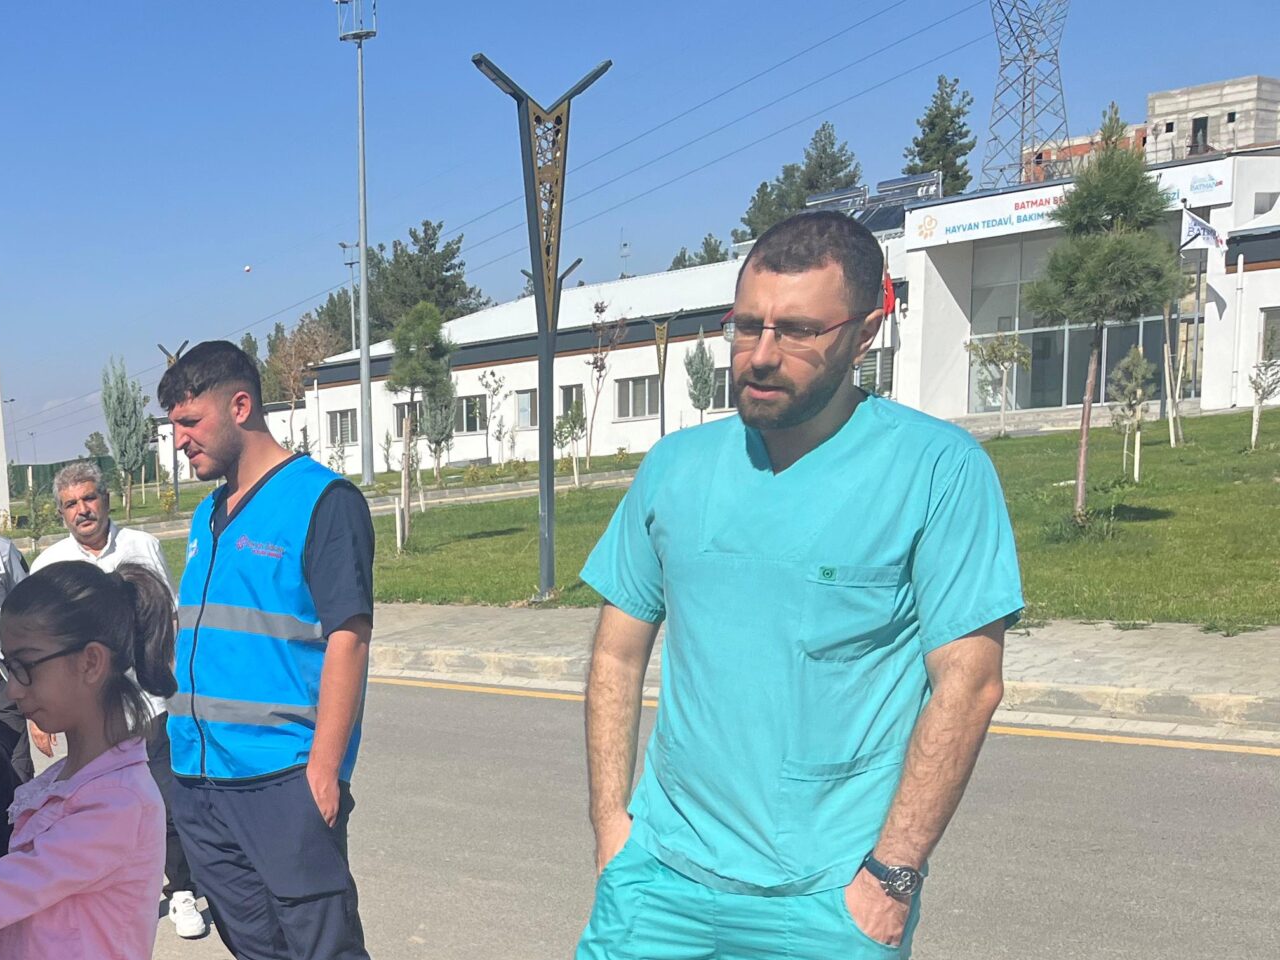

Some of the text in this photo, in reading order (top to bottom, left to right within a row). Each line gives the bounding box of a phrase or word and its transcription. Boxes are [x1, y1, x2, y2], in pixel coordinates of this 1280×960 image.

[1014, 197, 1051, 211] BATMAN
[945, 222, 980, 235] HAYVAN
[981, 214, 1014, 229] TEDAVİ,
[1016, 211, 1044, 224] BAKIM
